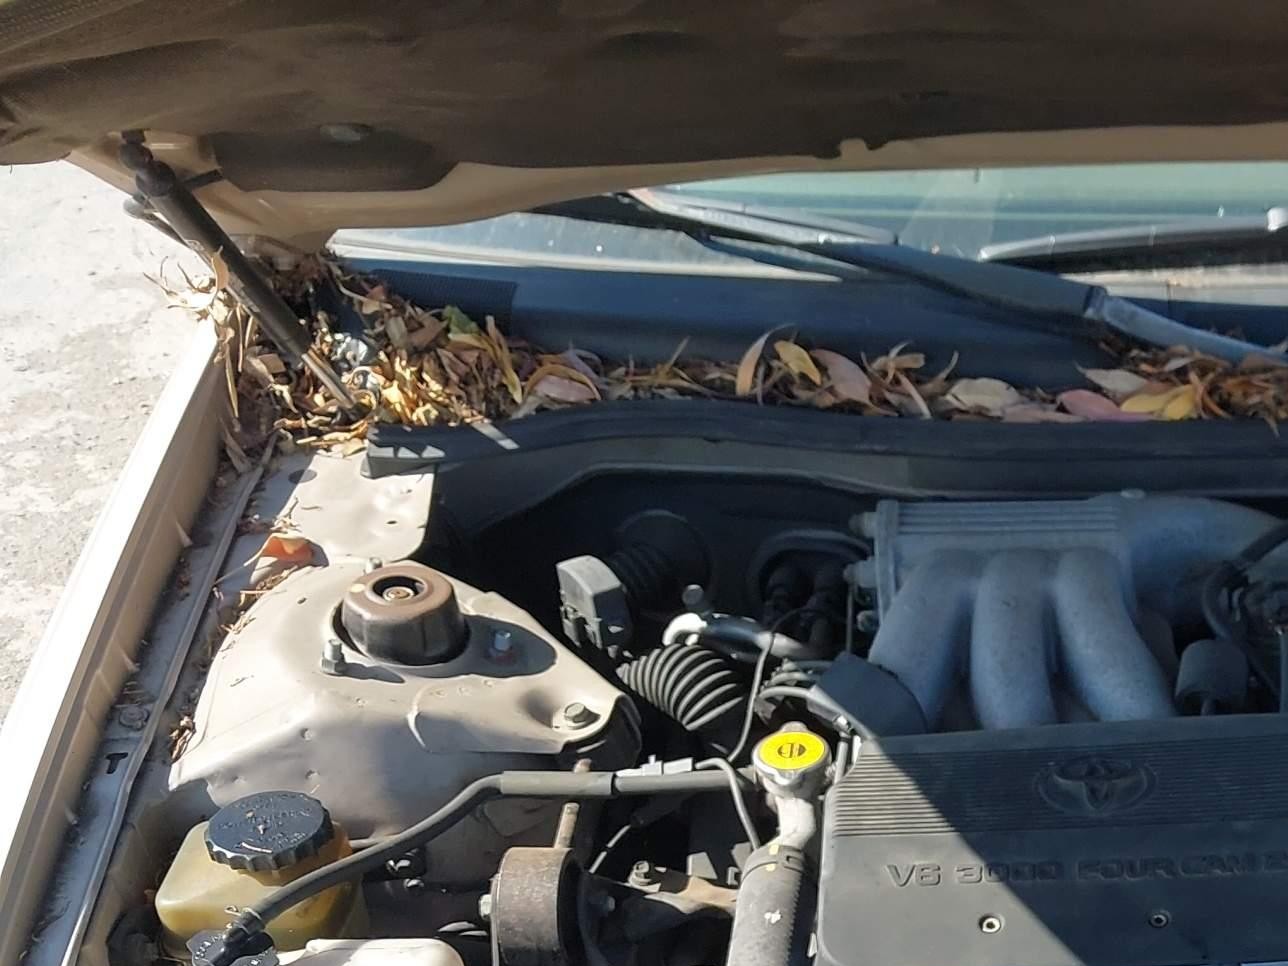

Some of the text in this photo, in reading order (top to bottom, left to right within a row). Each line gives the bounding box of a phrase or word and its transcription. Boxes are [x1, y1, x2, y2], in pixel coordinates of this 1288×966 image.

[886, 862, 943, 887] V6
[955, 860, 1064, 885] 3000
[1077, 856, 1178, 882] FOUR
